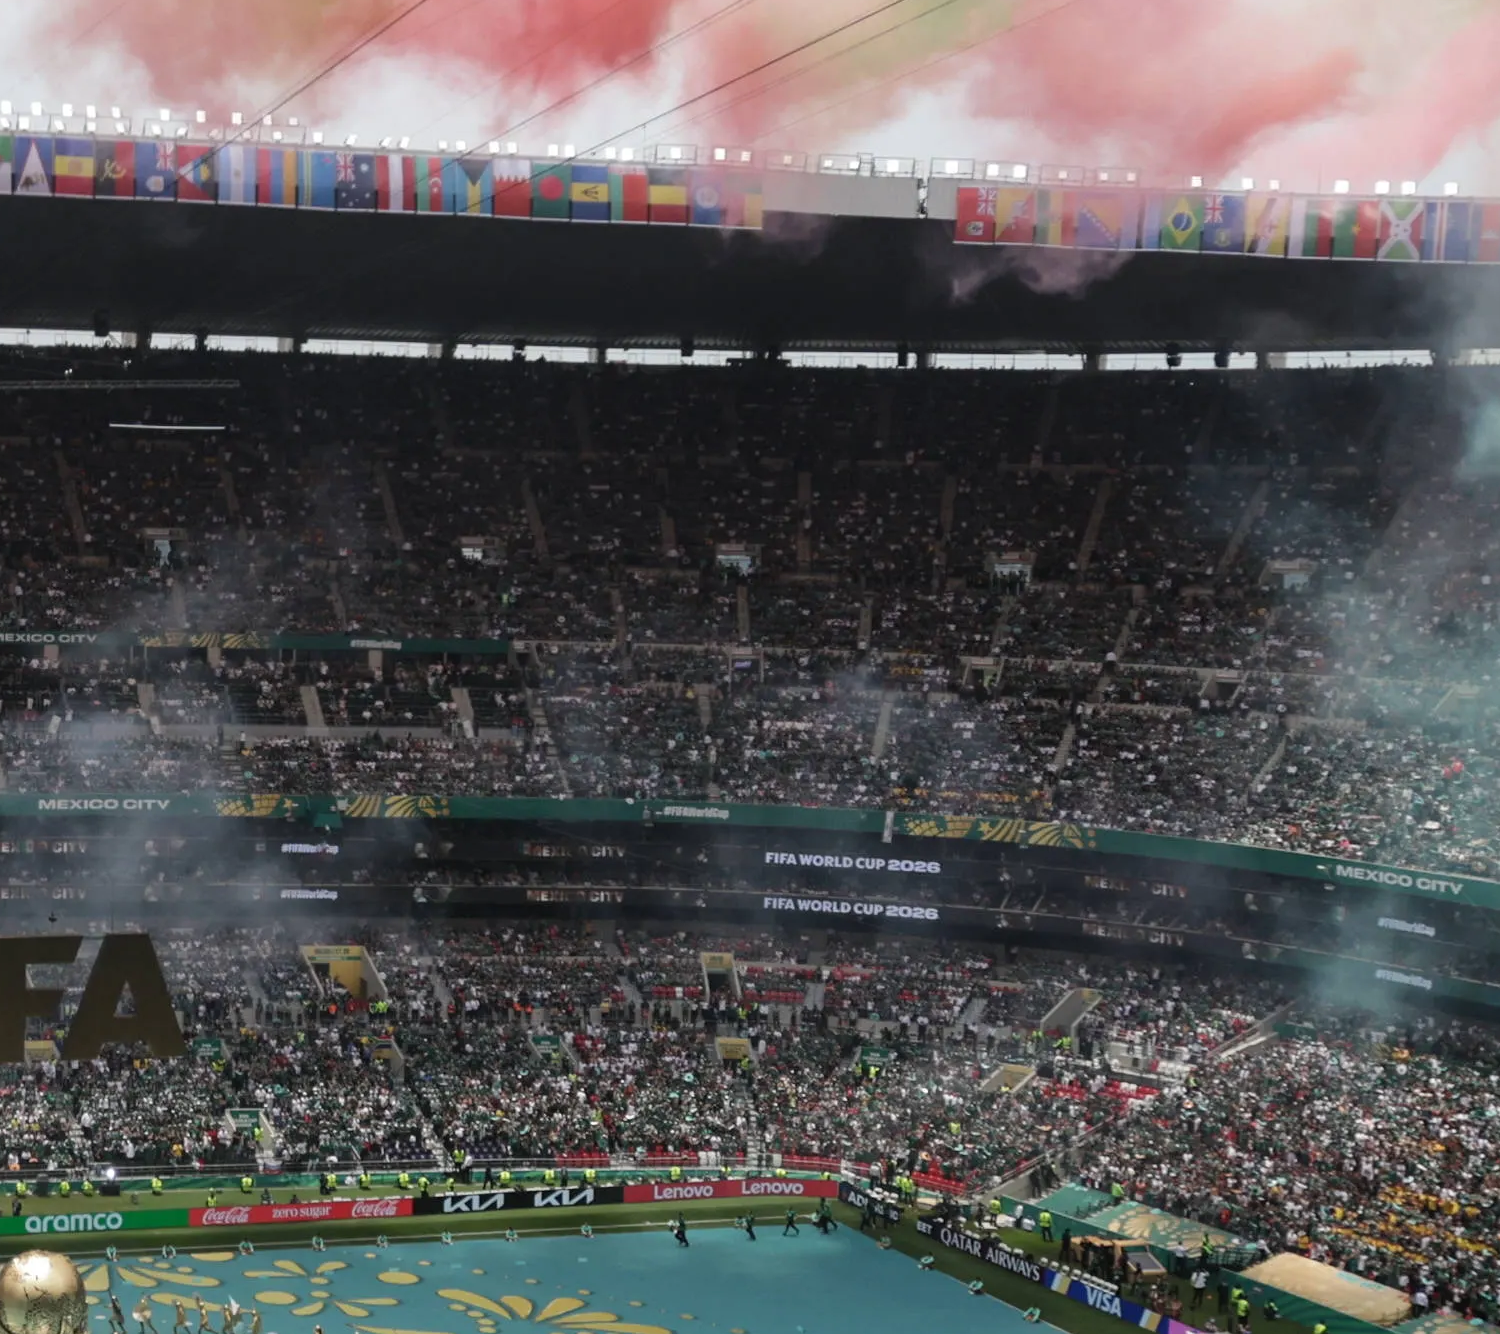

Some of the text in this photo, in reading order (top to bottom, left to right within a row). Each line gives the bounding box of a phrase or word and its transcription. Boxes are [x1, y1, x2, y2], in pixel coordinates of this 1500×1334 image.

[57, 633, 98, 643] CITY
[37, 798, 170, 810] MEXICO CITY
[764, 852, 941, 874] FIFA WORLD CUP 2026
[1336, 866, 1465, 896] MEXICO CITY
[763, 896, 939, 920] FIFA WORLD CUP 2026
[534, 1187, 595, 1208] KIA
[653, 1184, 714, 1201] Lenovo
[741, 1180, 805, 1195] Lenovo
[271, 1206, 333, 1220] zero sugar
[443, 1193, 505, 1213] KIA
[24, 1211, 124, 1234] aramco
[939, 1226, 1041, 1283] QATAR AIRWAYS
[1084, 1286, 1123, 1318] VISA
